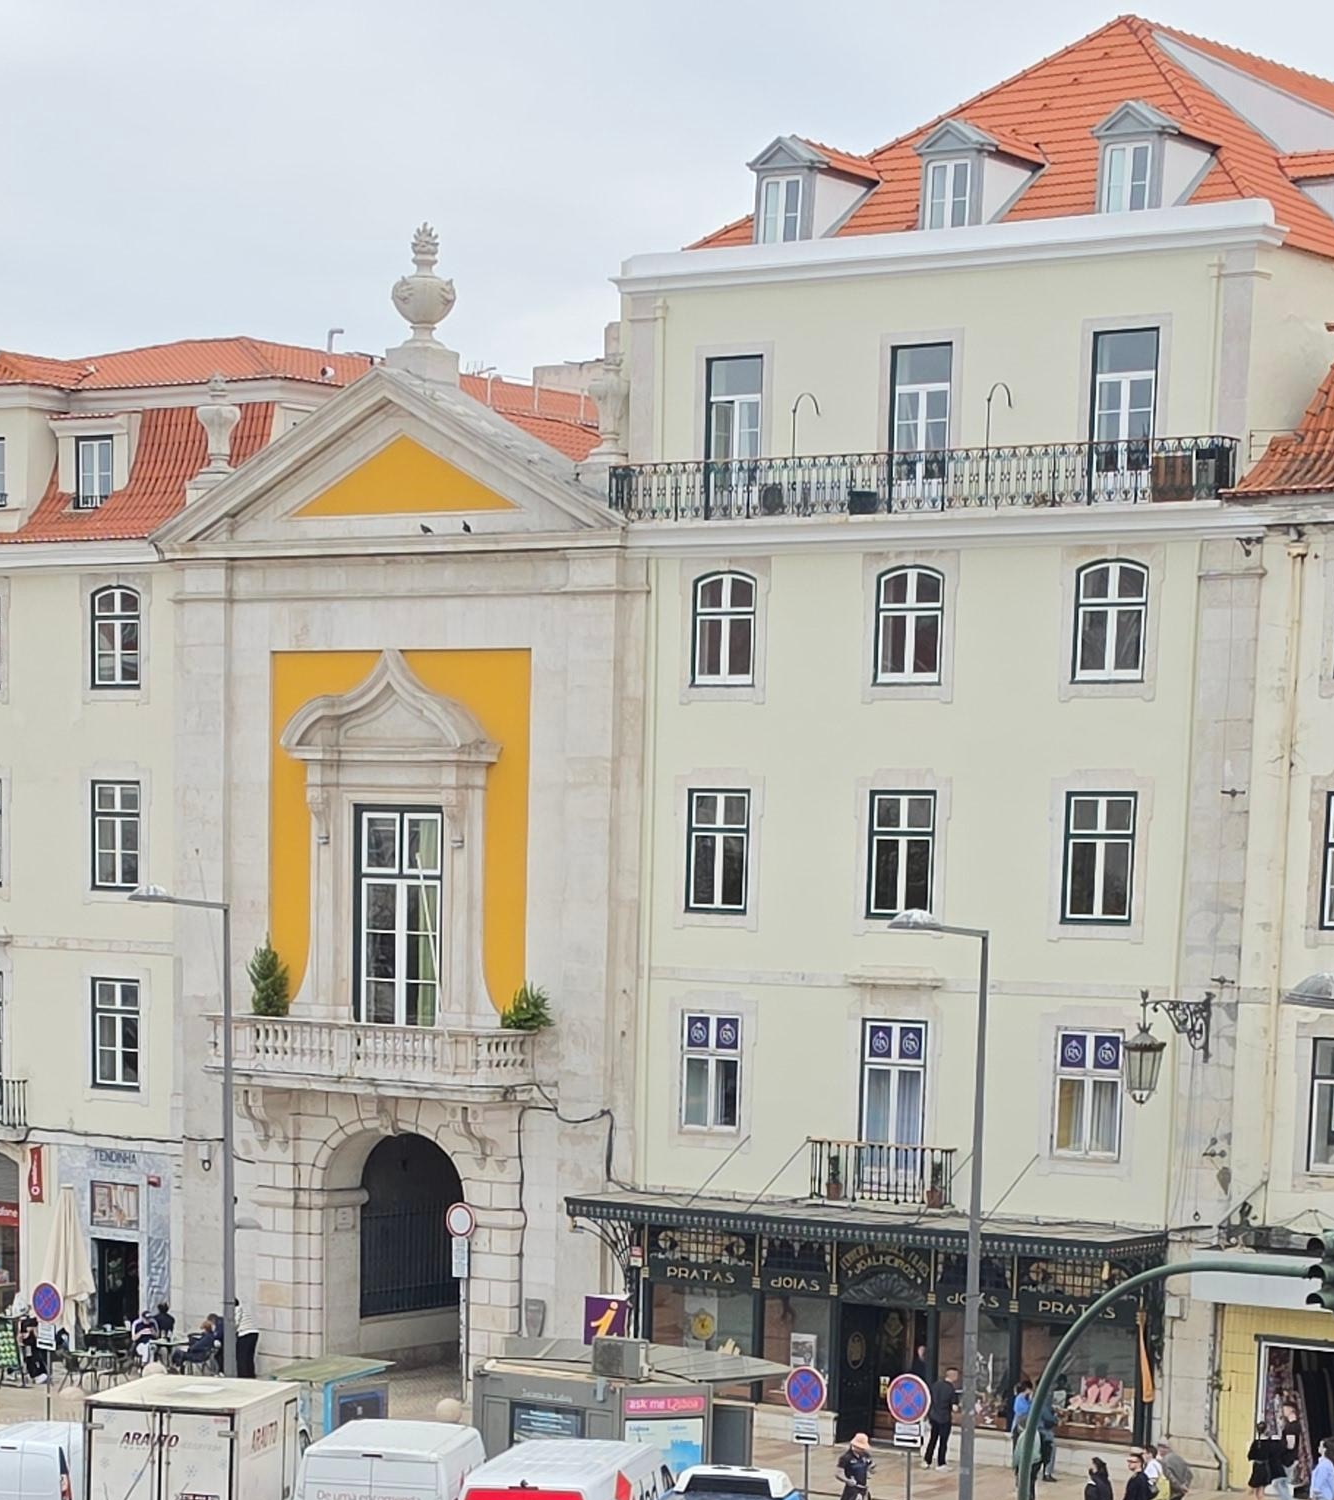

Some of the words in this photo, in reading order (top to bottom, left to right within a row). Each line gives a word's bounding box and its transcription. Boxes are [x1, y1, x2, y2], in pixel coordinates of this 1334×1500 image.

[93, 1149, 138, 1165] TENDINHA
[666, 1266, 735, 1284] PRATAS
[770, 1275, 820, 1292] JOIAS
[1038, 1299, 1116, 1319] PRATS
[629, 1398, 647, 1410] ask
[649, 1400, 665, 1409] me
[120, 1431, 180, 1448] ARAUTO
[317, 1489, 331, 1500] De
